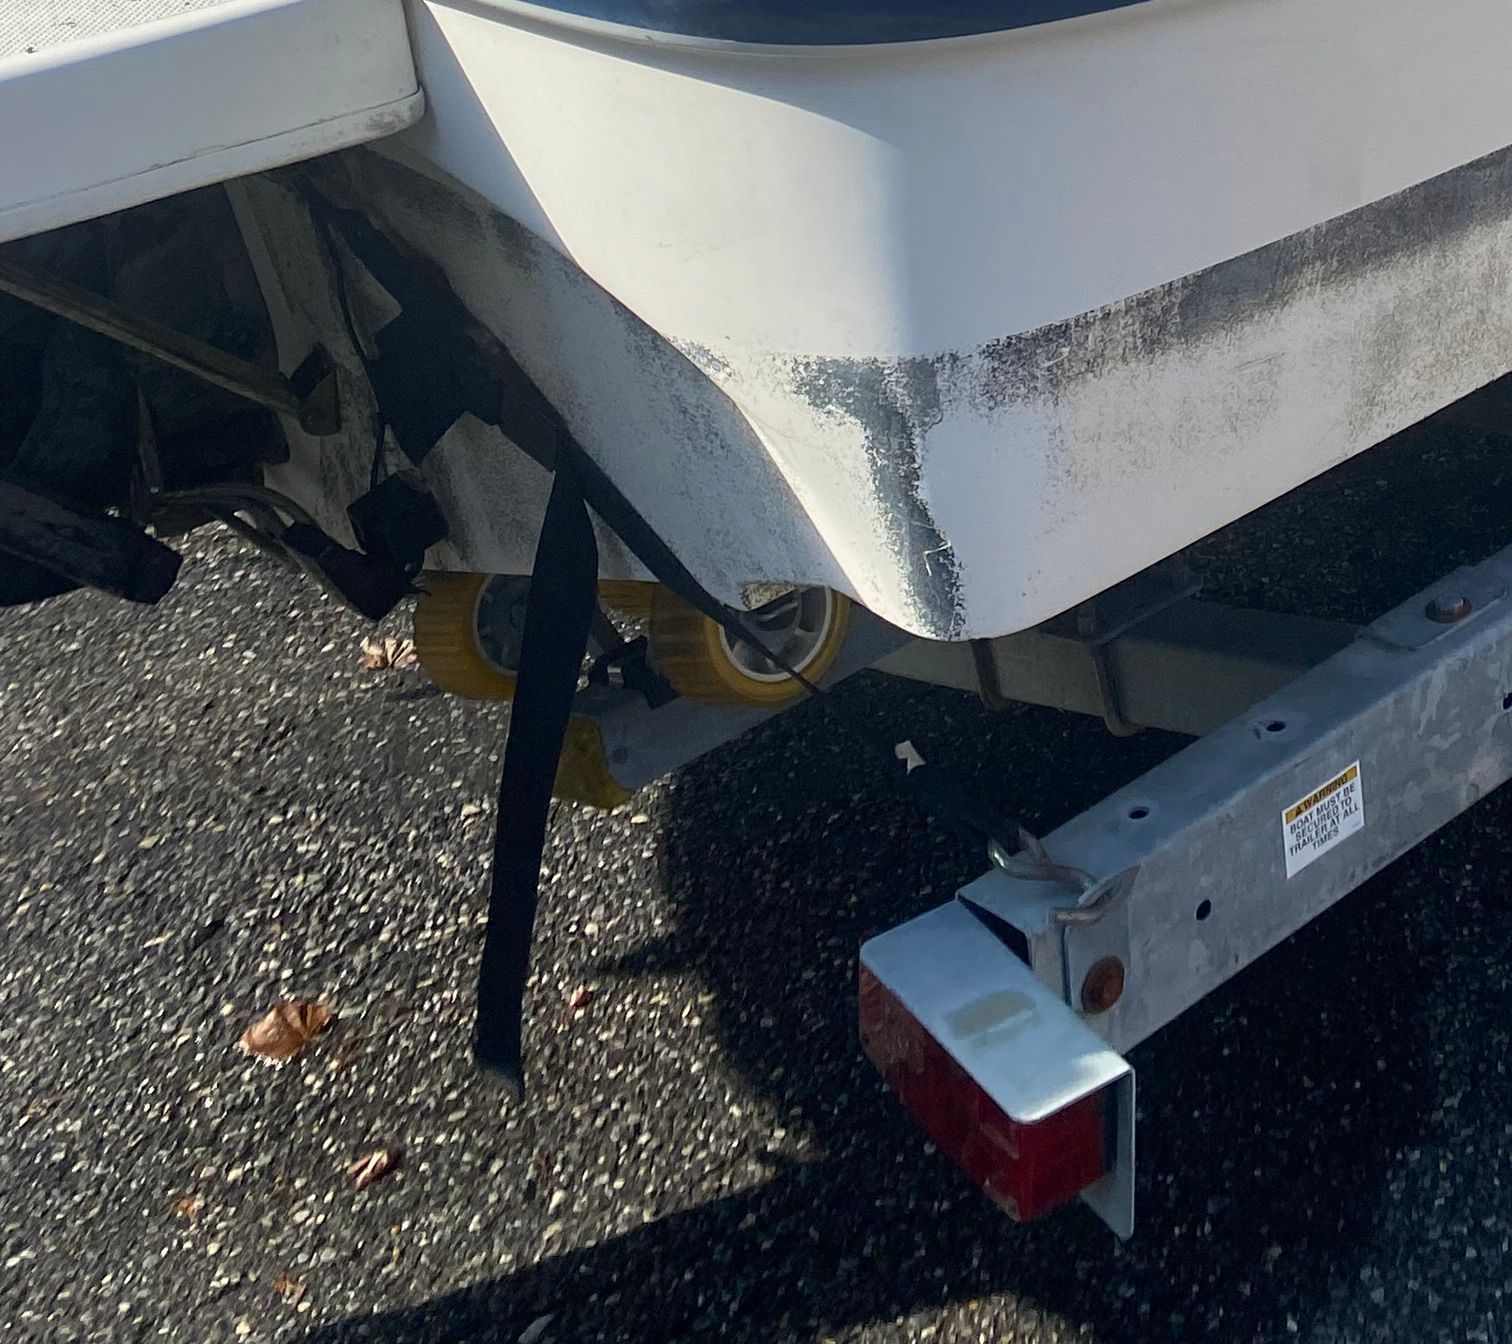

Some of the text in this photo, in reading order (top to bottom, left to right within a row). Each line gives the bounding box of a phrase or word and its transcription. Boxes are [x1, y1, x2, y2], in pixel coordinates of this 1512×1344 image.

[1290, 782, 1355, 834] BOAT MUST BE
[1303, 773, 1348, 810] WARNING
[1290, 824, 1327, 856] TRAILER
[1330, 815, 1341, 830] AT
[1343, 802, 1359, 820] ALL
[1296, 796, 1352, 841] SECURED TO
[1313, 825, 1339, 850] TIMES
